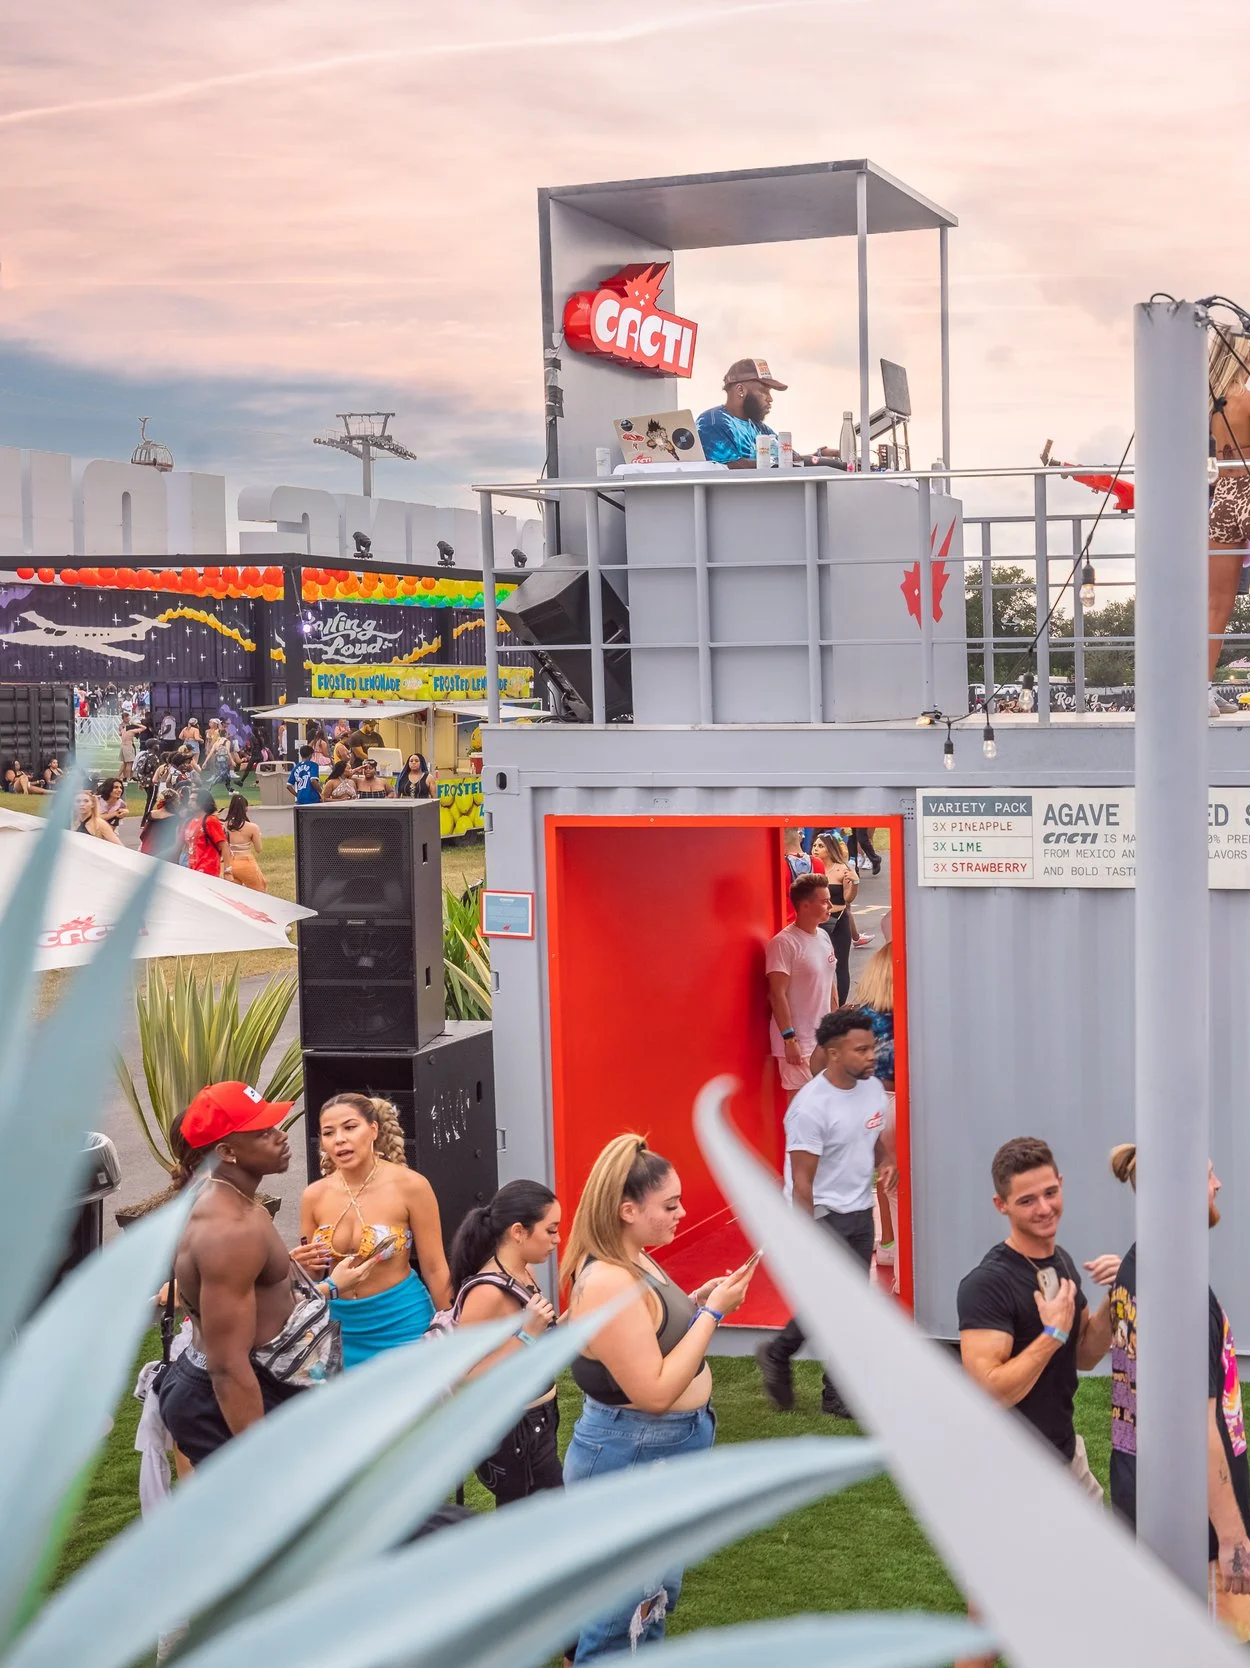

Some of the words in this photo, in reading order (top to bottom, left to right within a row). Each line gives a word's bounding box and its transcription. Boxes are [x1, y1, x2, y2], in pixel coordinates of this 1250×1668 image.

[595, 298, 693, 369] CACTI
[318, 672, 356, 691] FROSTED
[359, 673, 400, 692] LEMONADE
[433, 674, 471, 692] FROSTED
[929, 802, 986, 813] VARIETY
[994, 803, 1027, 813] PACK
[1043, 803, 1120, 826] AGAVE
[932, 823, 947, 832] 3X
[951, 821, 1013, 832] PINEAPPLE
[1043, 832, 1098, 844] CACTI
[1103, 834, 1117, 843] IS
[932, 842, 947, 851] 3X
[951, 842, 982, 852] LIME
[1043, 849, 1070, 858] FROM
[1075, 849, 1116, 859] MEXICO
[1121, 849, 1136, 859] AN
[1208, 850, 1248, 859] LAVORS
[933, 863, 947, 872] 3X
[951, 862, 1027, 873] STRAWBERRY
[1043, 867, 1064, 876] AND
[1071, 867, 1099, 876] BOLD
[1106, 867, 1136, 876] TAST
